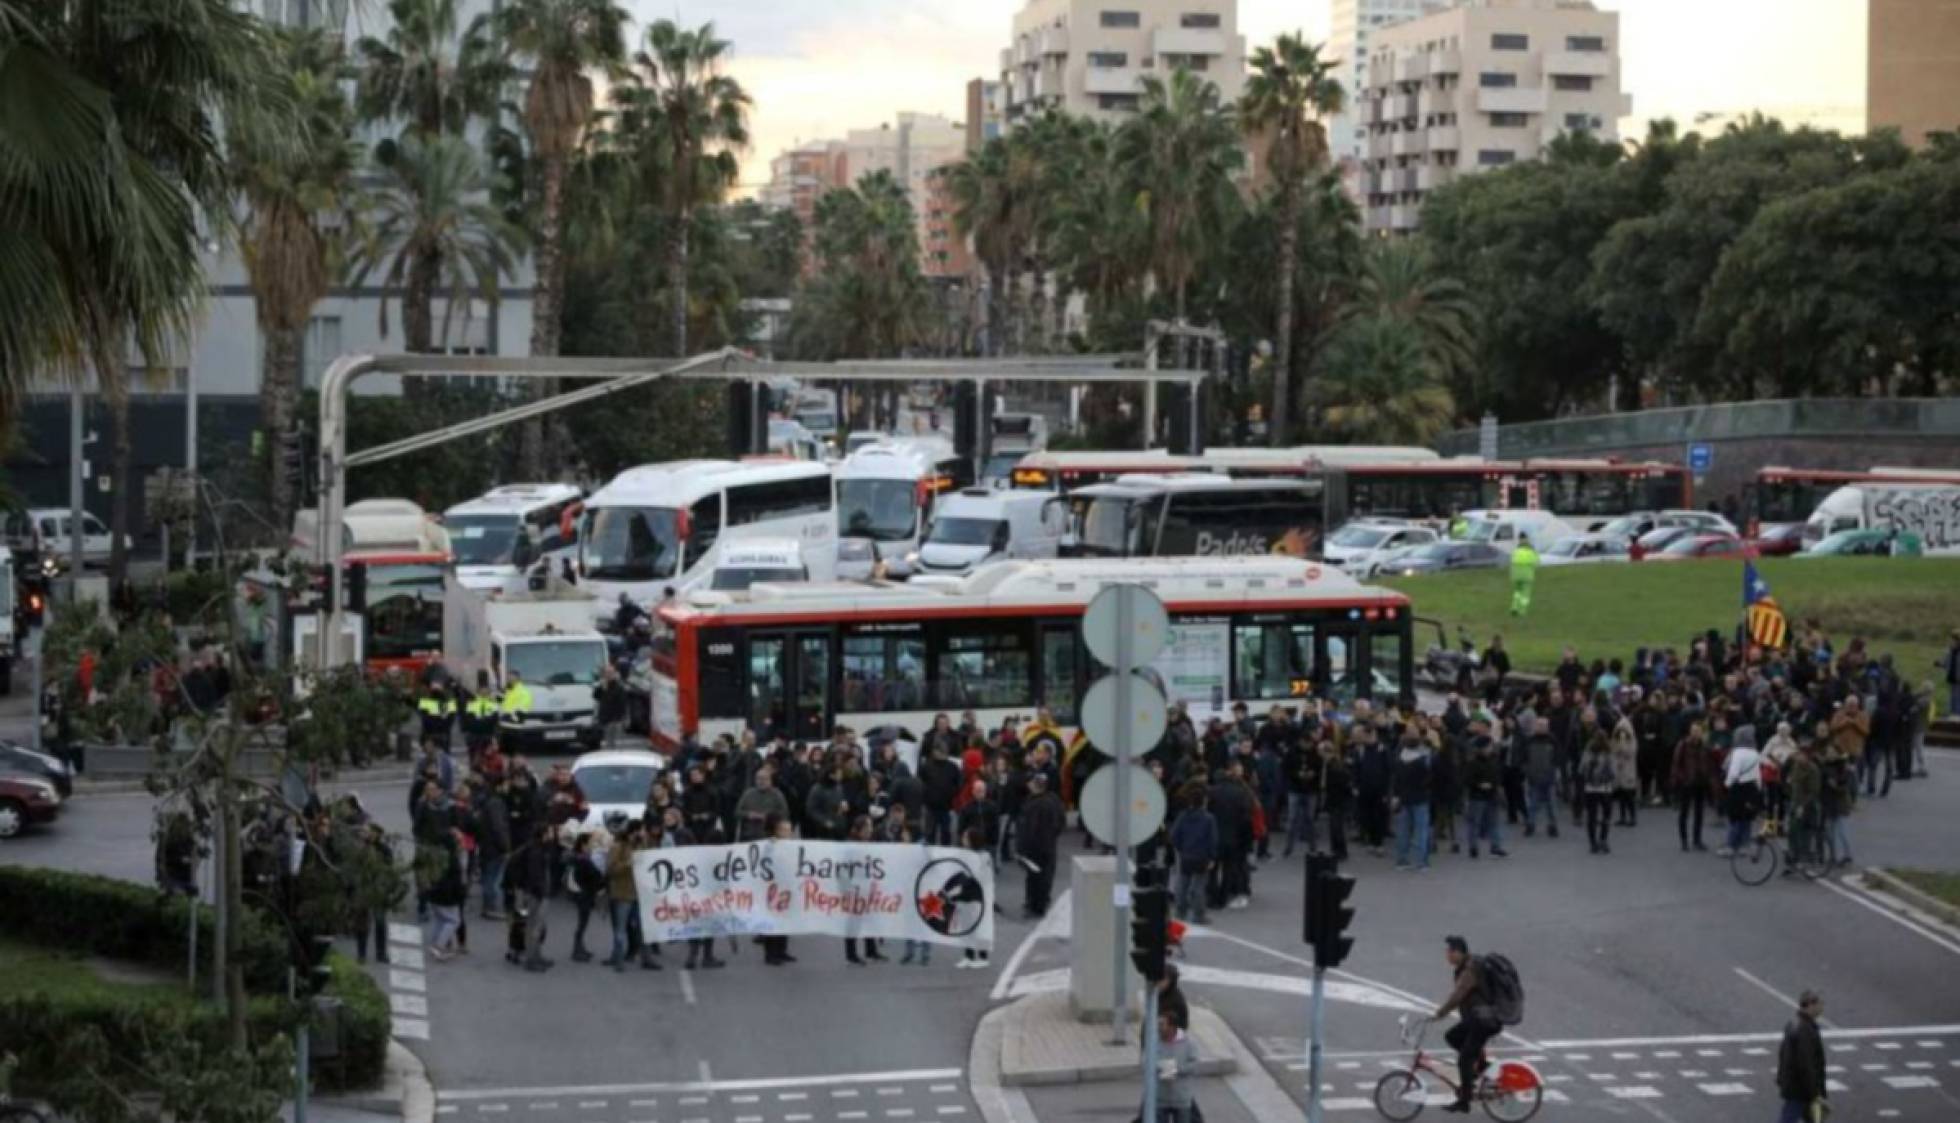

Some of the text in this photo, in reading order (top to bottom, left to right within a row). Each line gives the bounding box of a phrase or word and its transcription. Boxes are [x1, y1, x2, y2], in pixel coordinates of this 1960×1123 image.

[648, 843, 885, 893] Des dels barris
[766, 882, 791, 914] la
